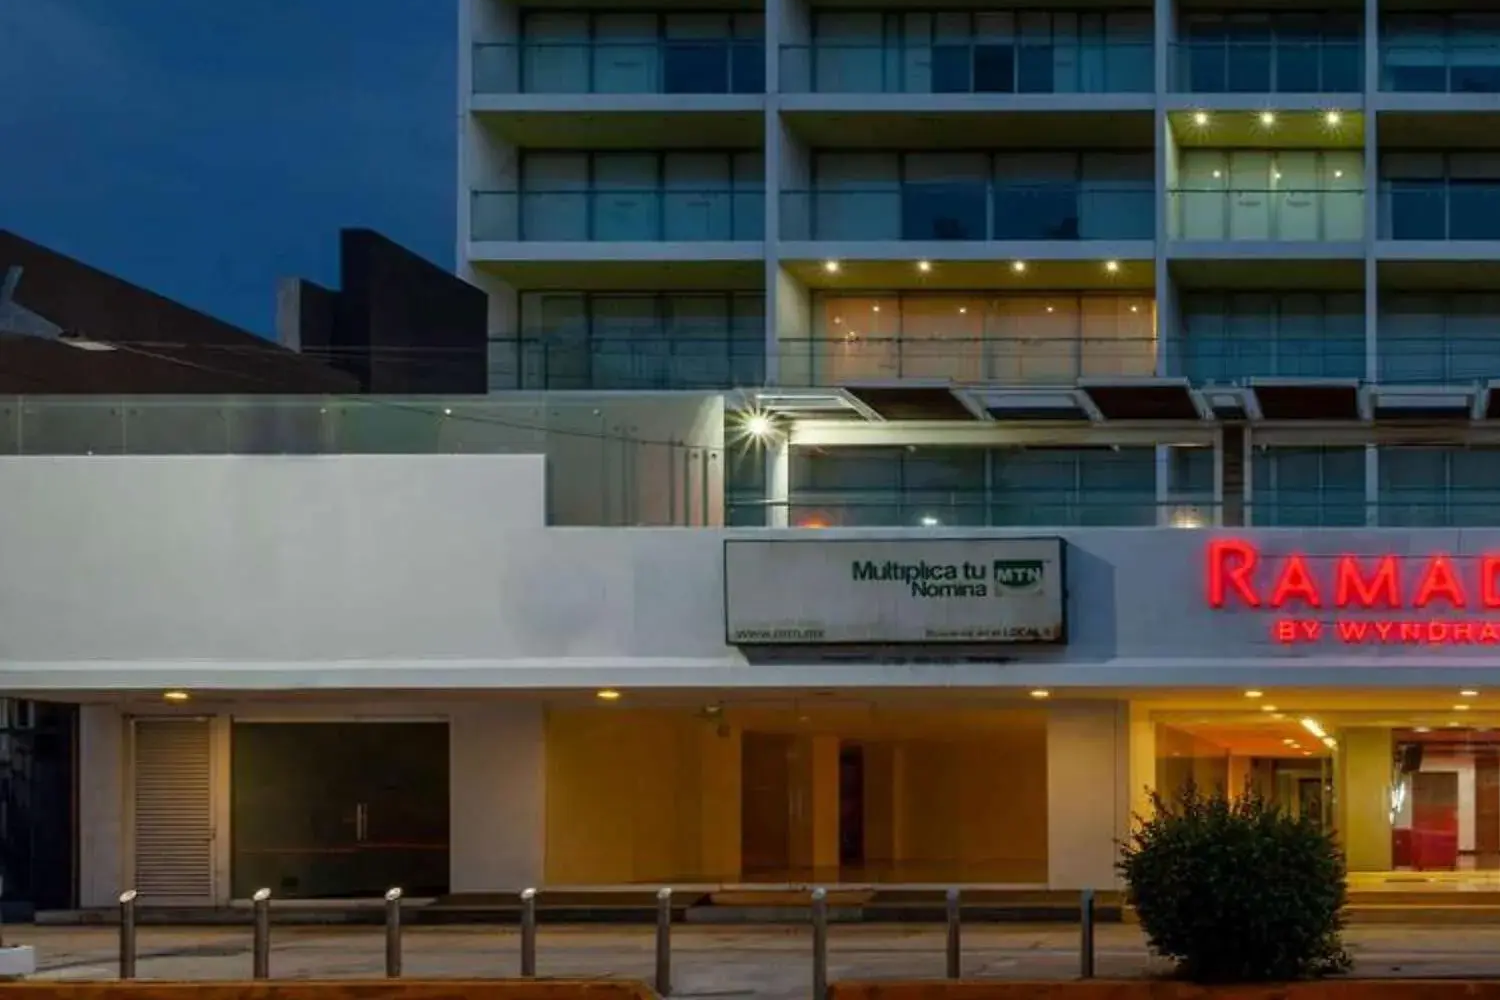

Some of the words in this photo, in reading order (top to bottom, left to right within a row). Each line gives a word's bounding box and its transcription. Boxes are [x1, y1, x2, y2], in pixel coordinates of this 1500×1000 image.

[852, 560, 957, 585] Multiplica
[963, 561, 987, 580] tu
[996, 567, 1042, 583] MTN
[1278, 620, 1319, 643] BY
